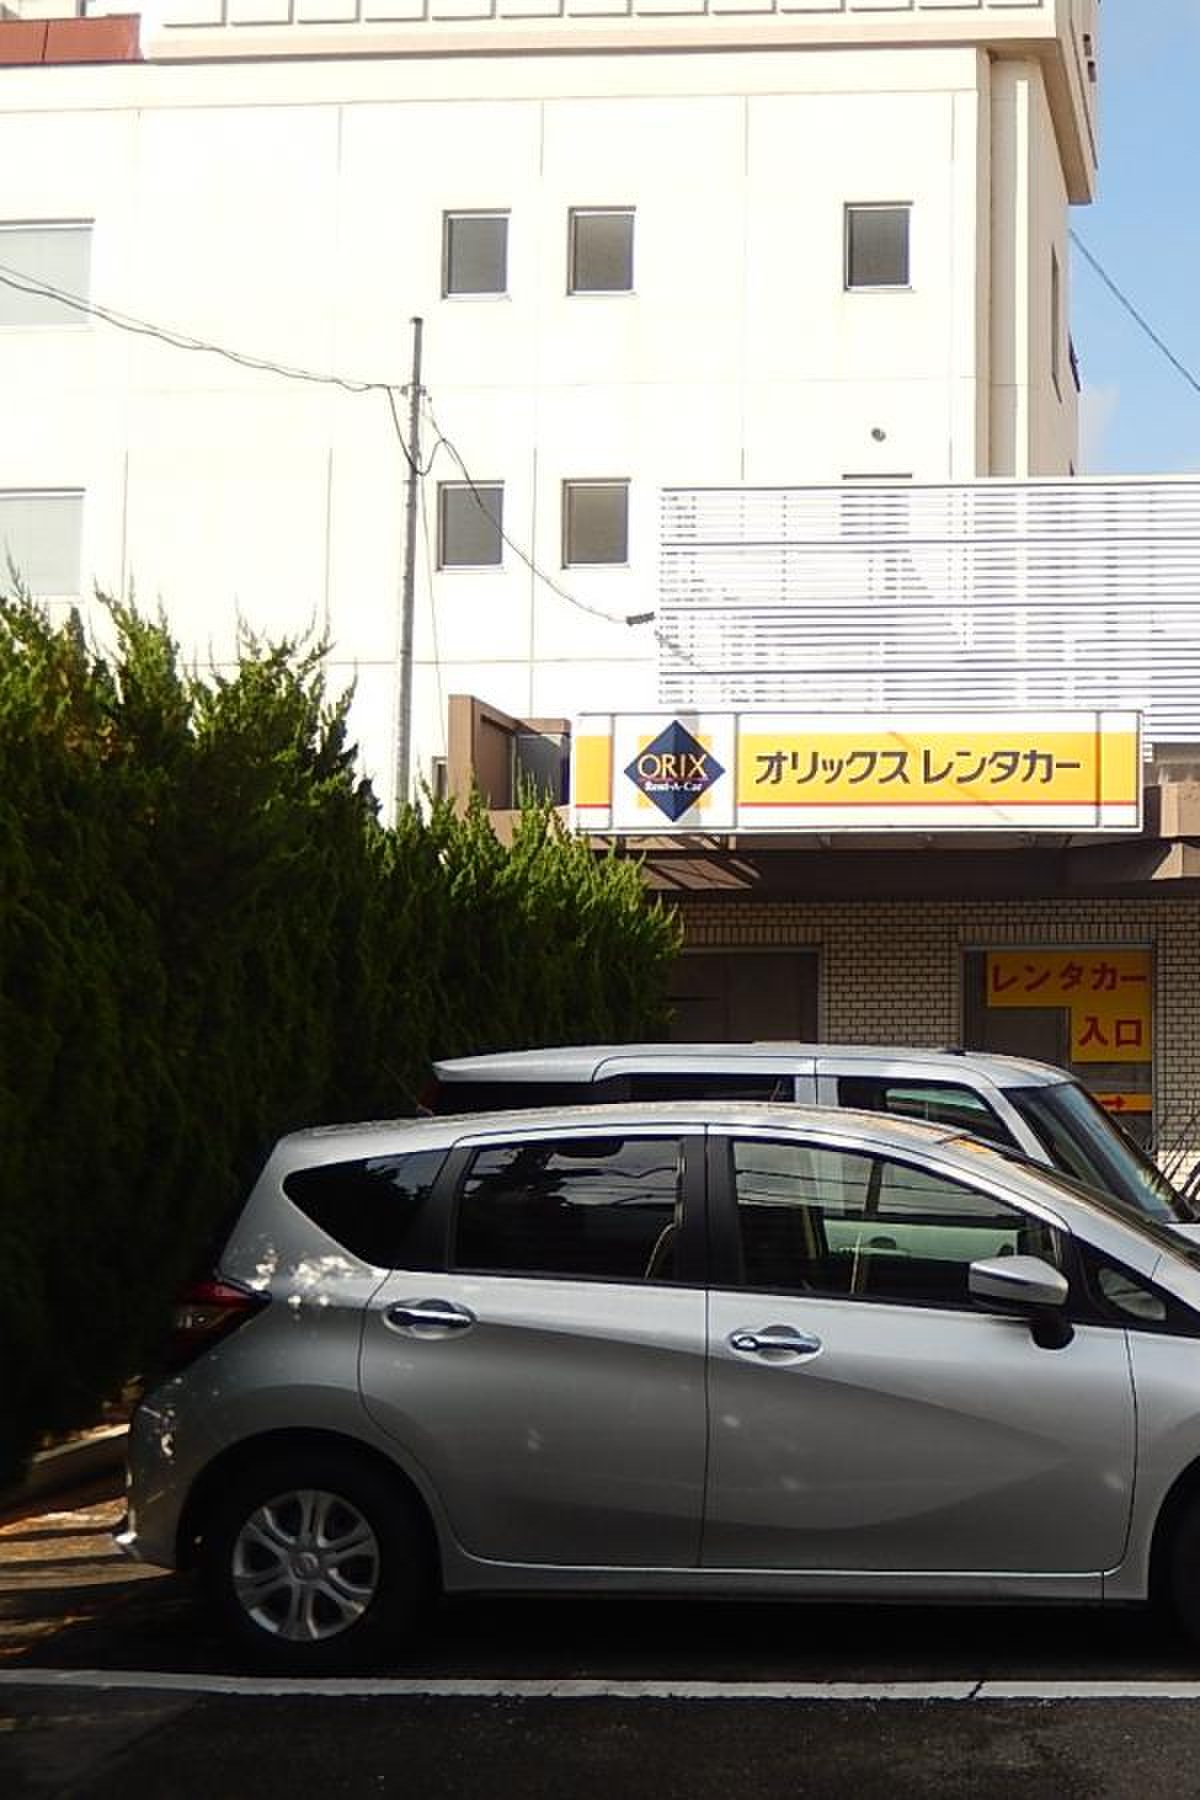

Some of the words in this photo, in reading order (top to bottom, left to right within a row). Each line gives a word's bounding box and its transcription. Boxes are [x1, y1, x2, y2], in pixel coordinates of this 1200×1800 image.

[637, 753, 707, 779] ORIX
[992, 962, 1147, 992] レンタカー
[1078, 1016, 1143, 1047] 入口
